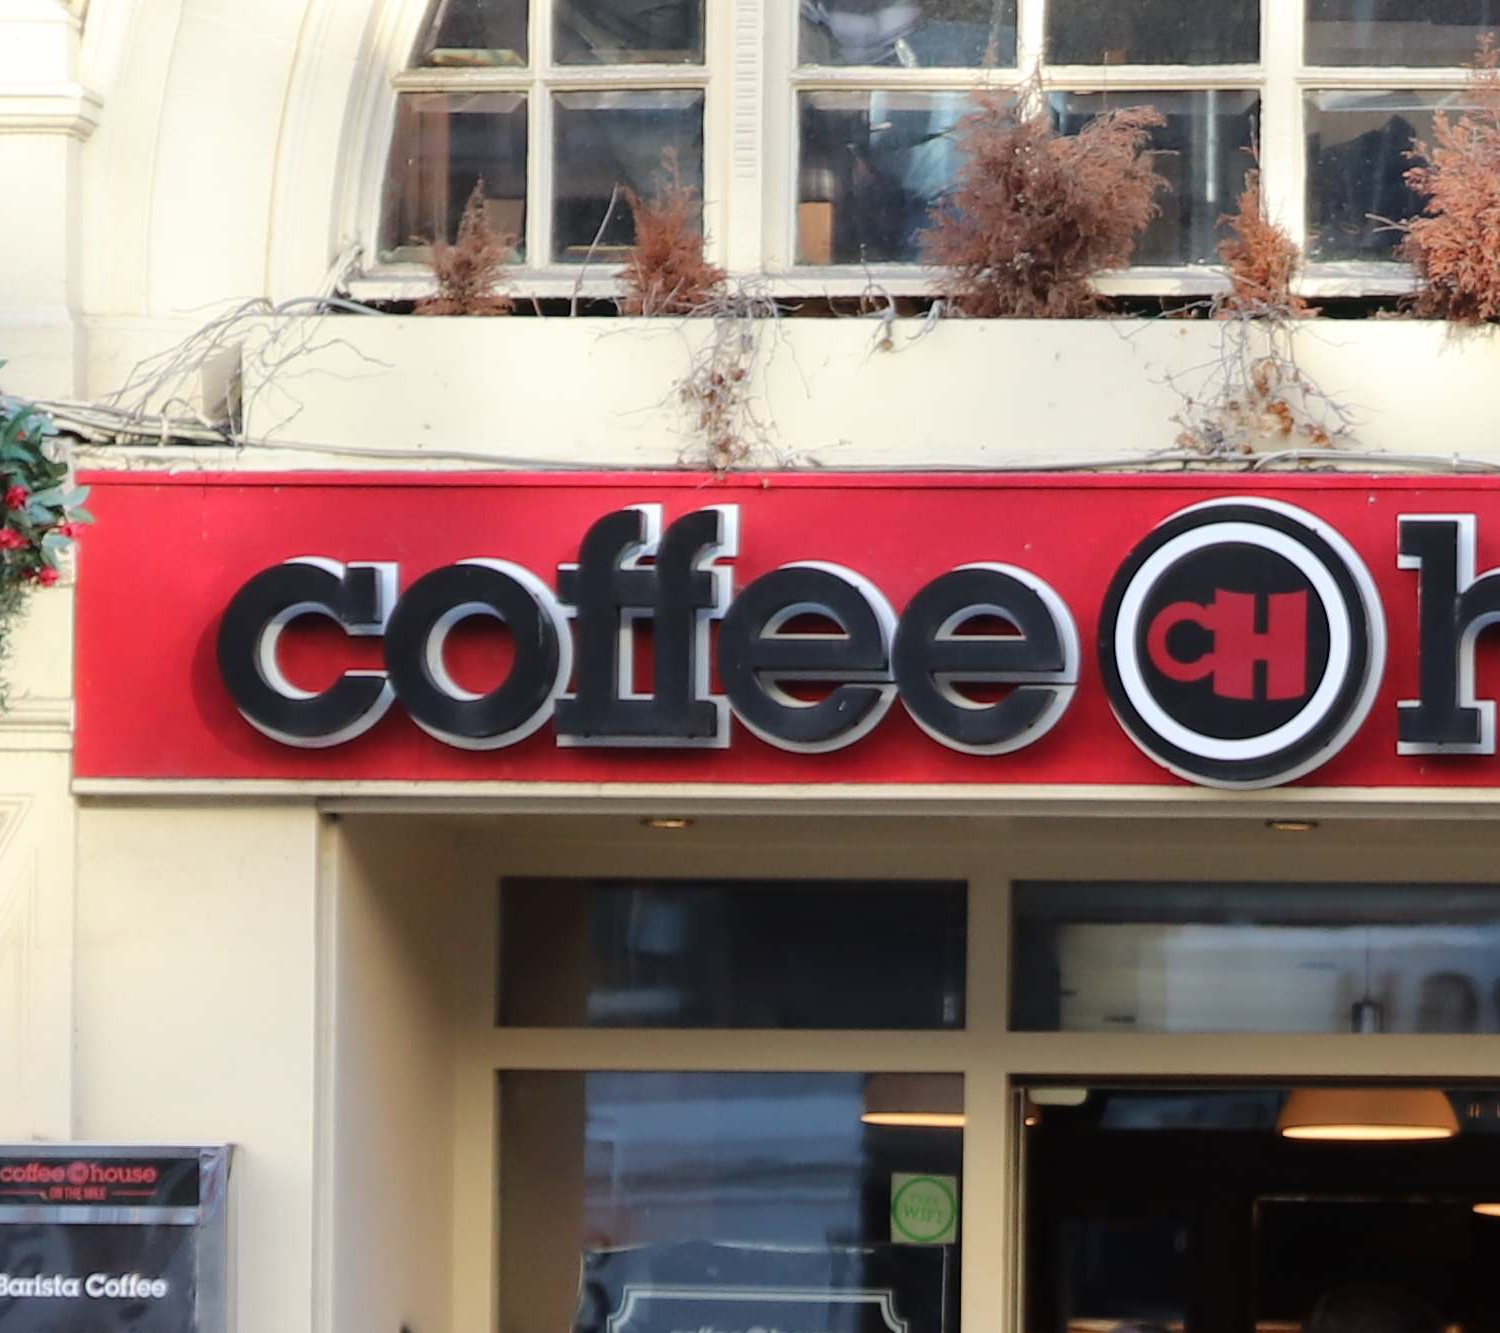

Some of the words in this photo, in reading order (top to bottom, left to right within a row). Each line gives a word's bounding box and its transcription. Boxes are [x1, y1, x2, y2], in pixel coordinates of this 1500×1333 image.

[216, 500, 1078, 751] coffee
[0, 1162, 66, 1183] coffee
[89, 1162, 158, 1183] house
[85, 1273, 168, 1299] Coffee
